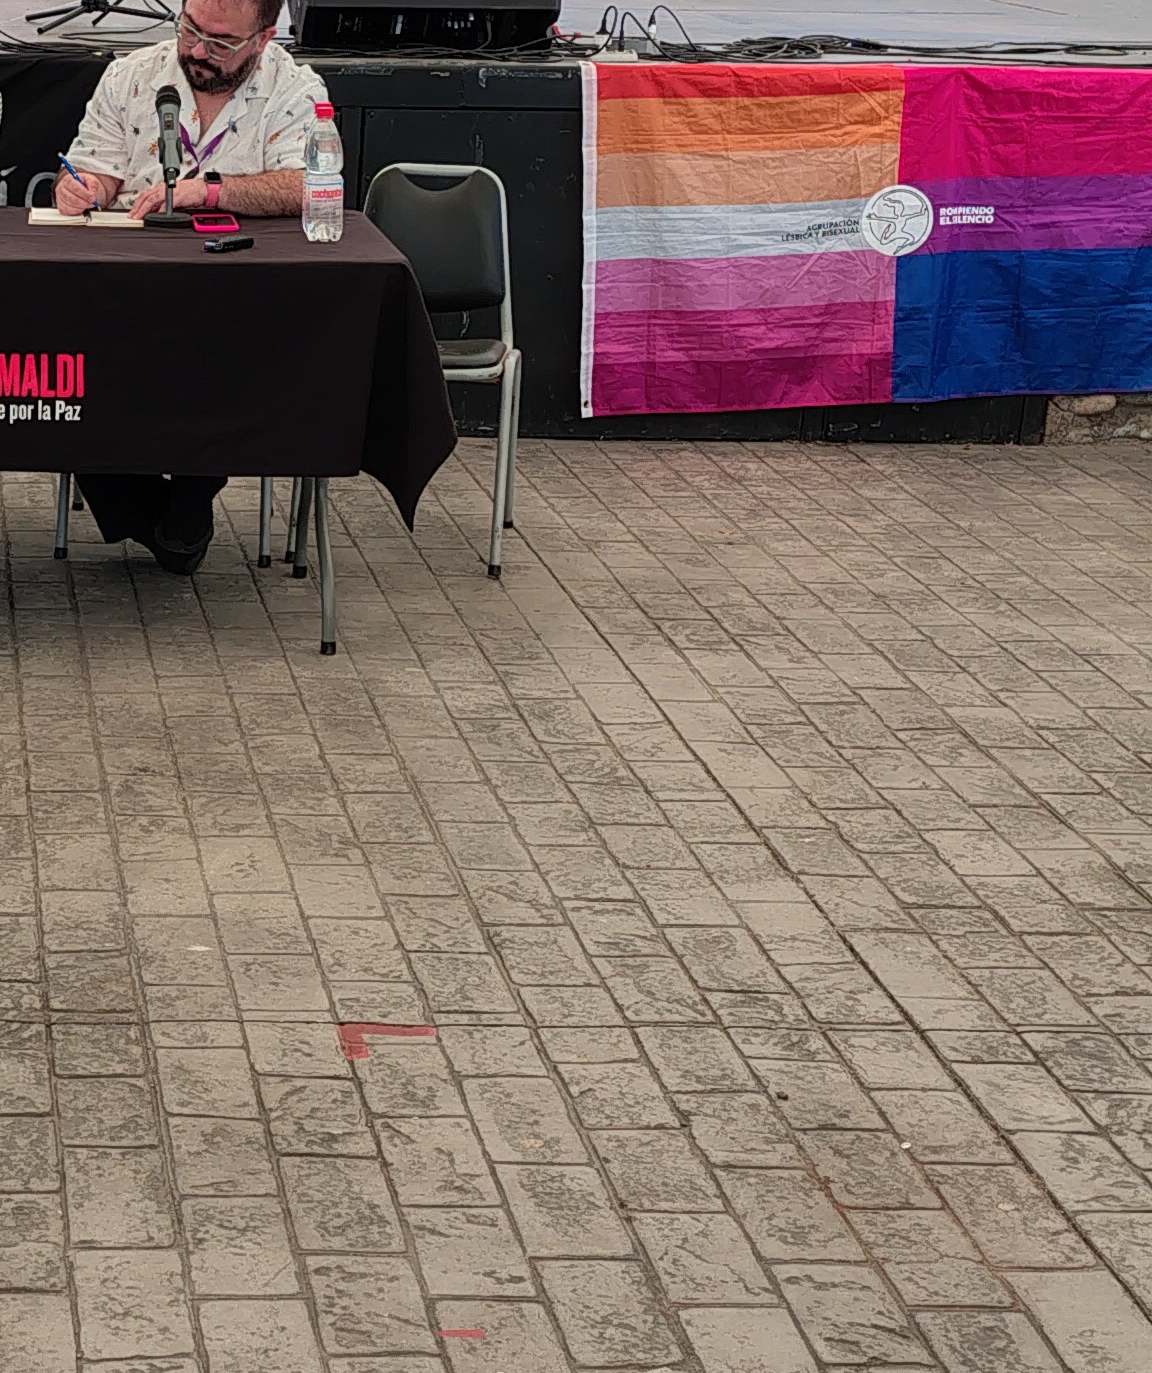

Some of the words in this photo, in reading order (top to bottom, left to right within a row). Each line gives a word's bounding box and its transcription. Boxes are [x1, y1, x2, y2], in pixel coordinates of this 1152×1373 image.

[806, 219, 860, 232] AGRUPACIÓN
[822, 226, 860, 237] BISEXUAL
[9, 404, 35, 424] por
[38, 400, 51, 420] la
[54, 400, 82, 421] Paz
